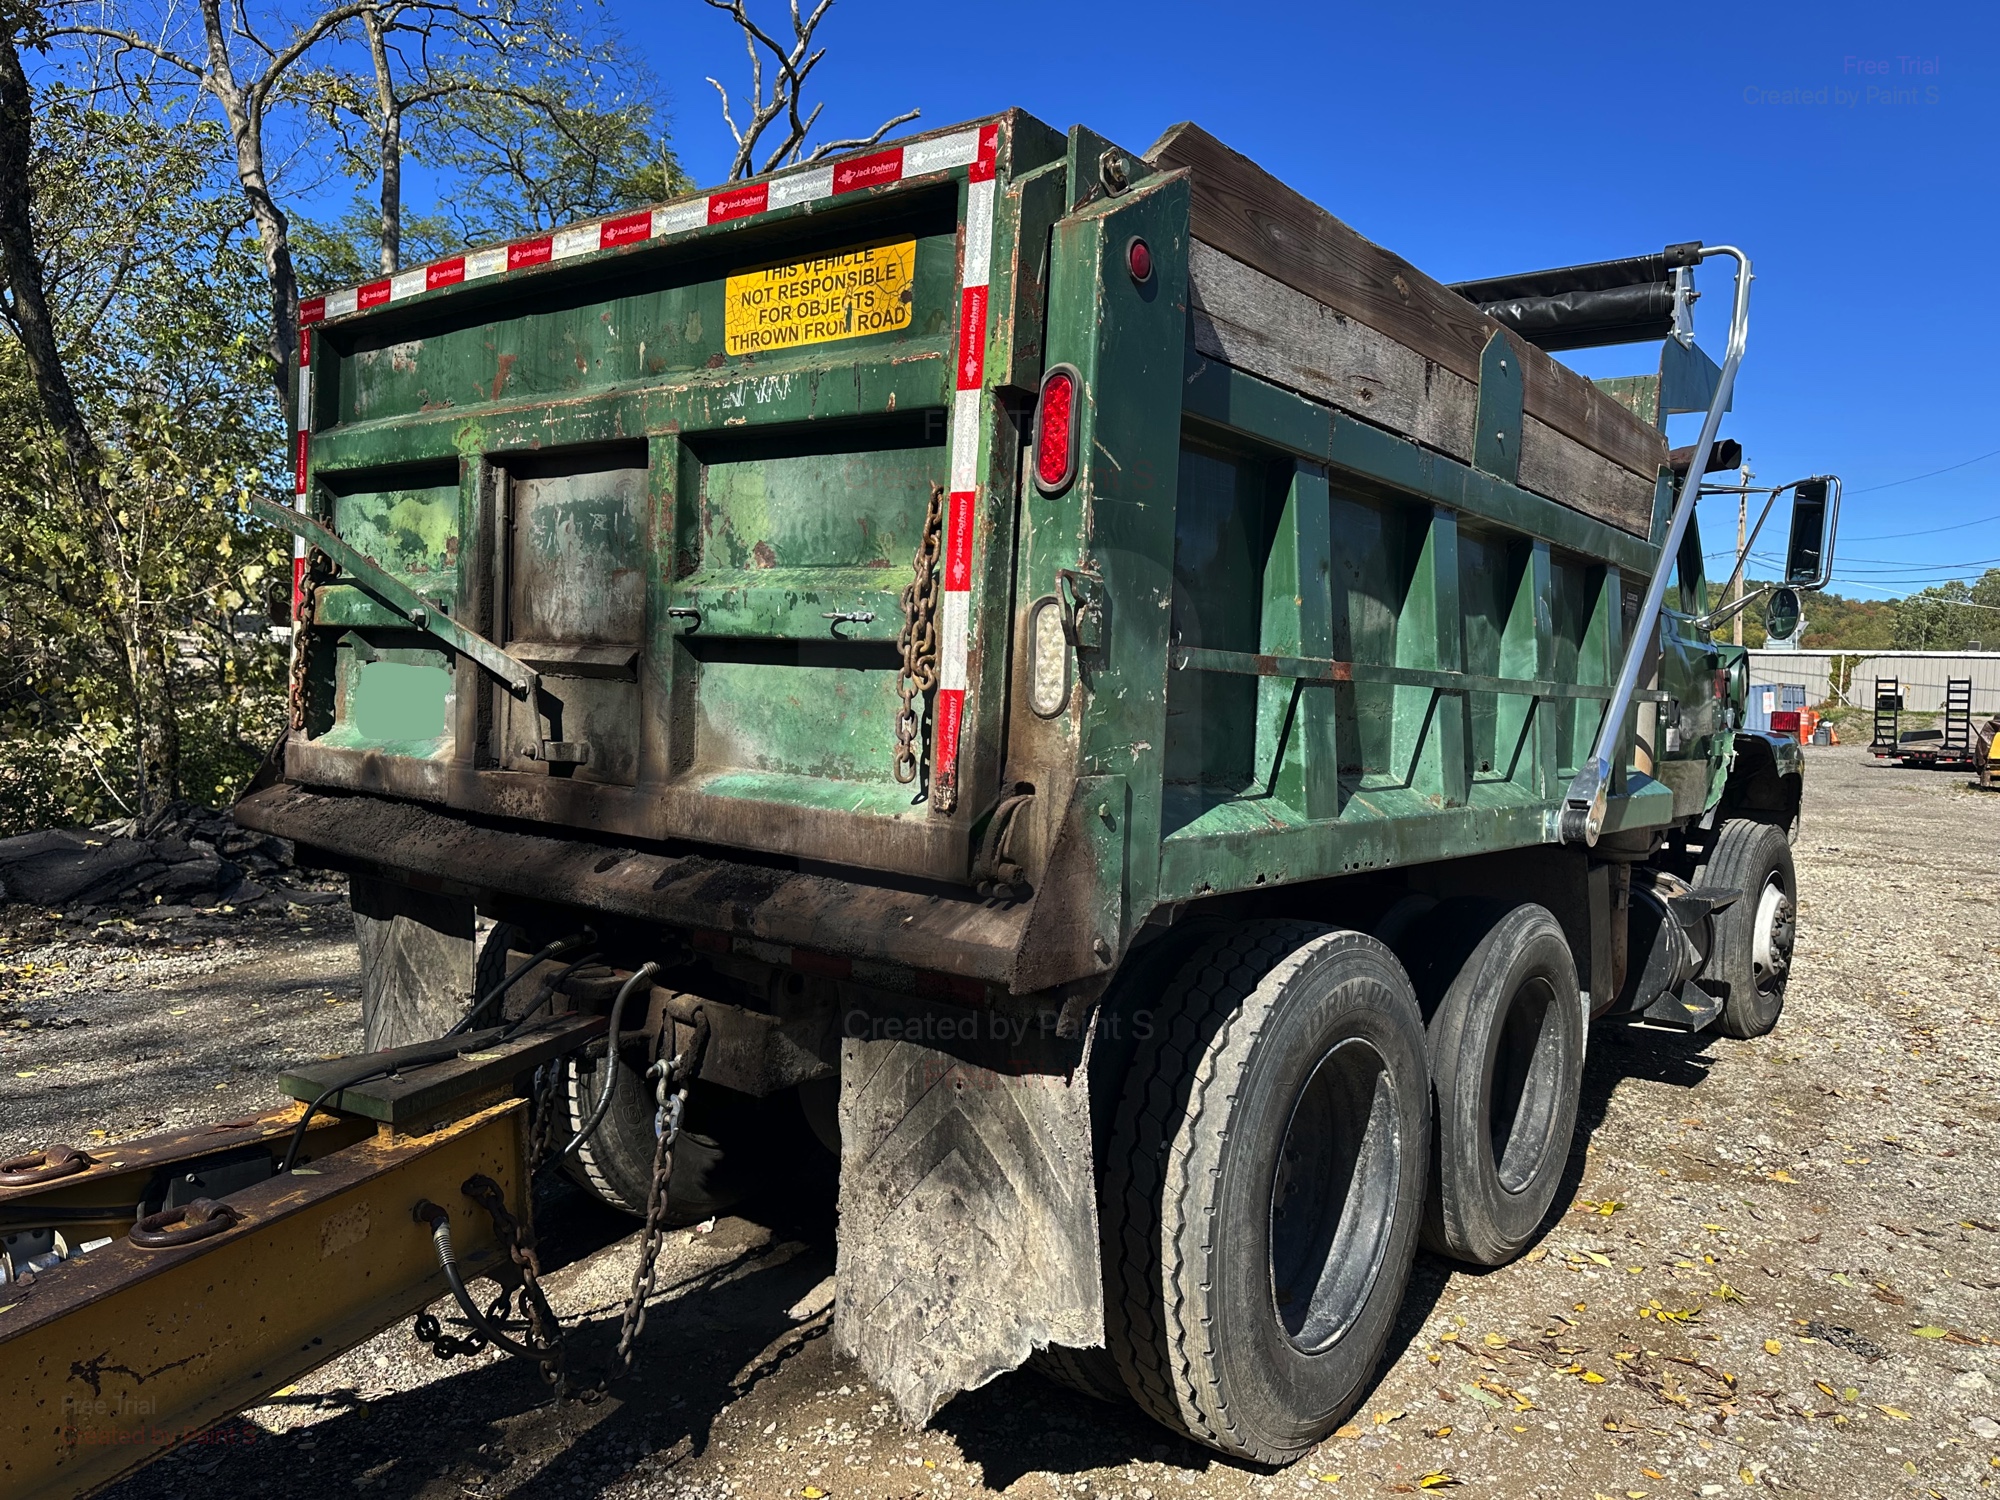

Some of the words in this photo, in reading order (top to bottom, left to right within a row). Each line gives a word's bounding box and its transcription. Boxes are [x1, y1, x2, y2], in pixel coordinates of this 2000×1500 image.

[856, 167, 871, 178] Jack
[871, 161, 899, 173] Doheny
[728, 199, 741, 209] Jack
[741, 194, 765, 205] Doheny
[617, 226, 629, 236] Jack
[629, 222, 649, 233] Doheny
[522, 250, 532, 258] Jack
[763, 261, 798, 282] THIS
[803, 245, 875, 274] VEHICLE
[741, 287, 774, 307] NOT
[778, 263, 897, 300] RESPONSIBLE
[758, 306, 792, 325] FOR
[969, 292, 981, 332] Doheny
[730, 326, 799, 350] THROWN
[858, 307, 906, 332] ROAD
[968, 333, 976, 356] Jack
[957, 498, 967, 536] Doheny
[955, 537, 963, 558] Jack
[948, 696, 958, 733] Doheny
[946, 734, 954, 754] Jack
